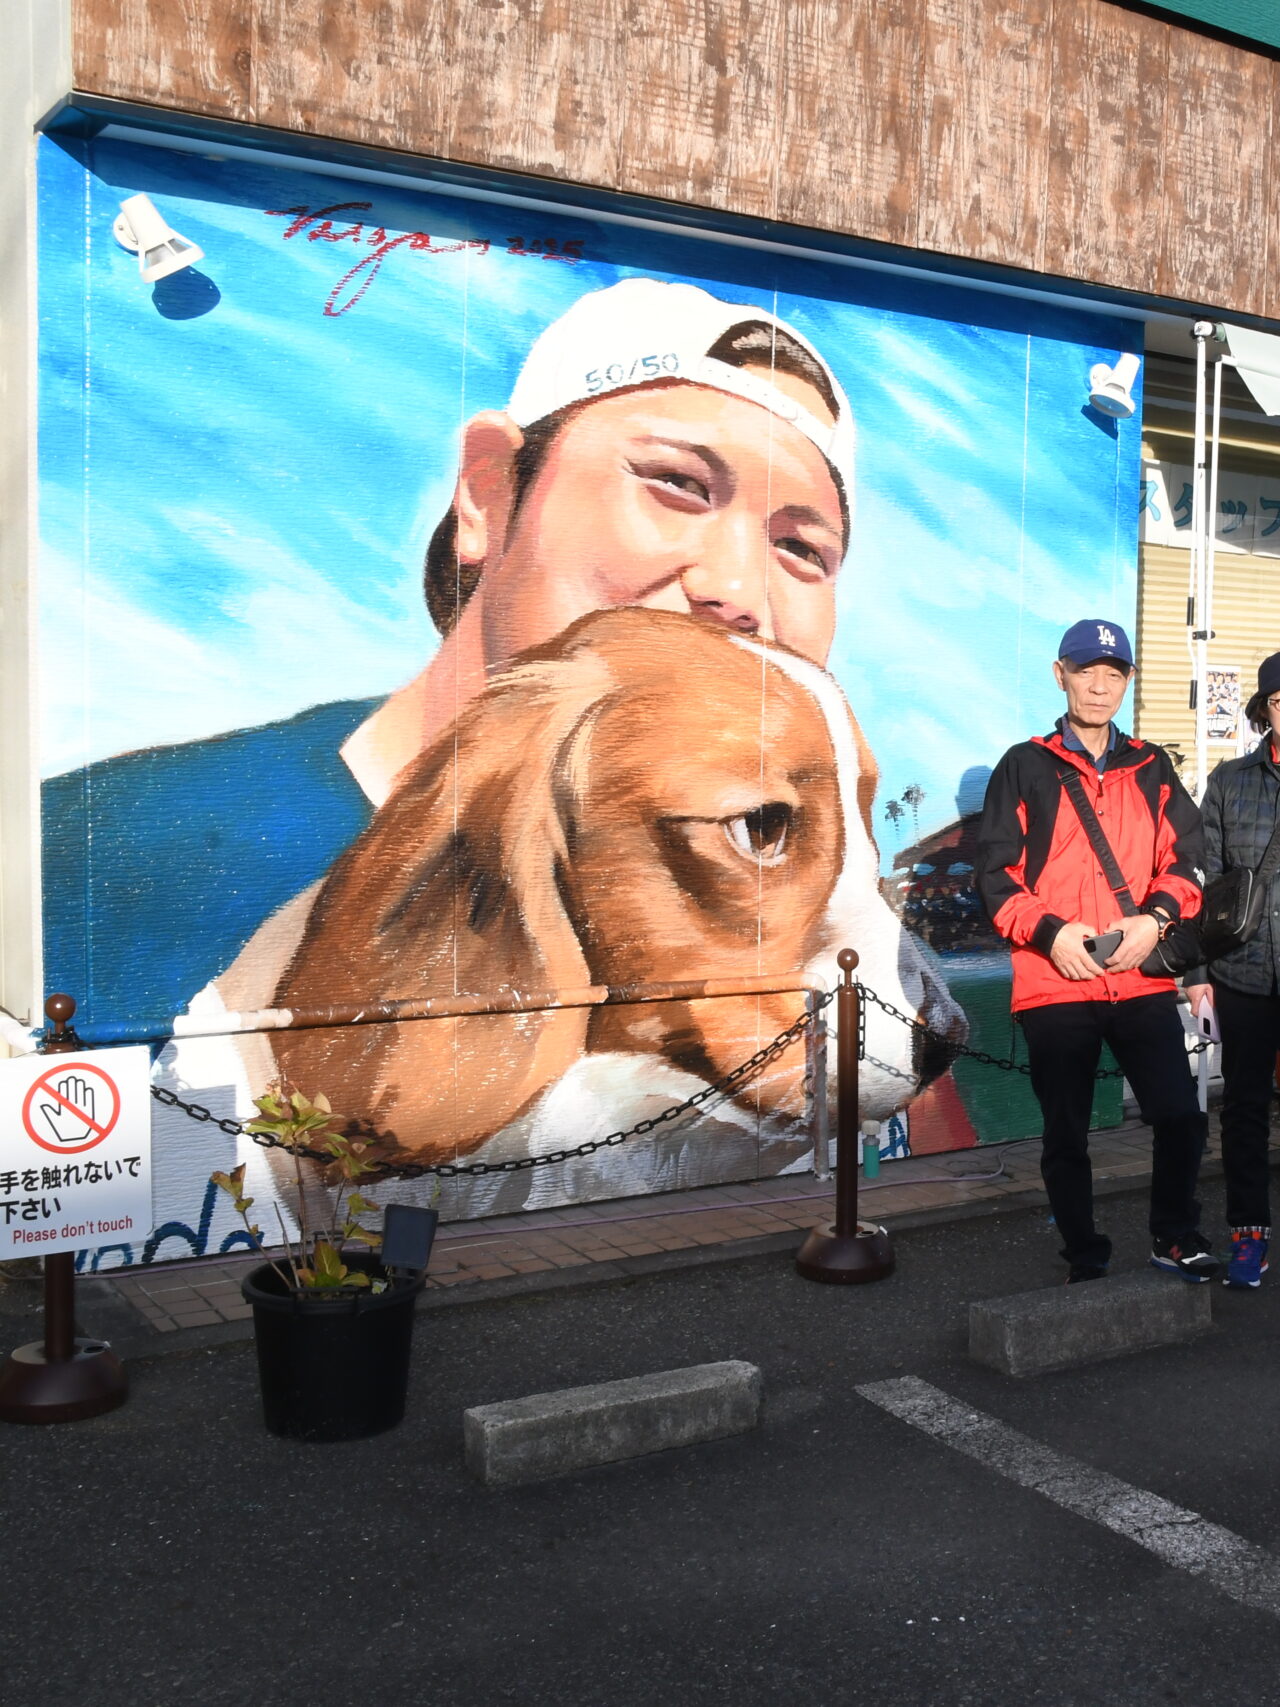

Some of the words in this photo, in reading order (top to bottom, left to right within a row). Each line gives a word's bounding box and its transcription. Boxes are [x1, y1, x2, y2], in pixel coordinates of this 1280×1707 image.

[585, 353, 680, 393] 50/50
[1097, 625, 1116, 646] LA
[0, 1156, 141, 1195] 手を触れないで
[0, 1198, 61, 1224] 下さい
[13, 1229, 57, 1244] Please
[61, 1221, 94, 1238] don't
[98, 1215, 133, 1233] touch
